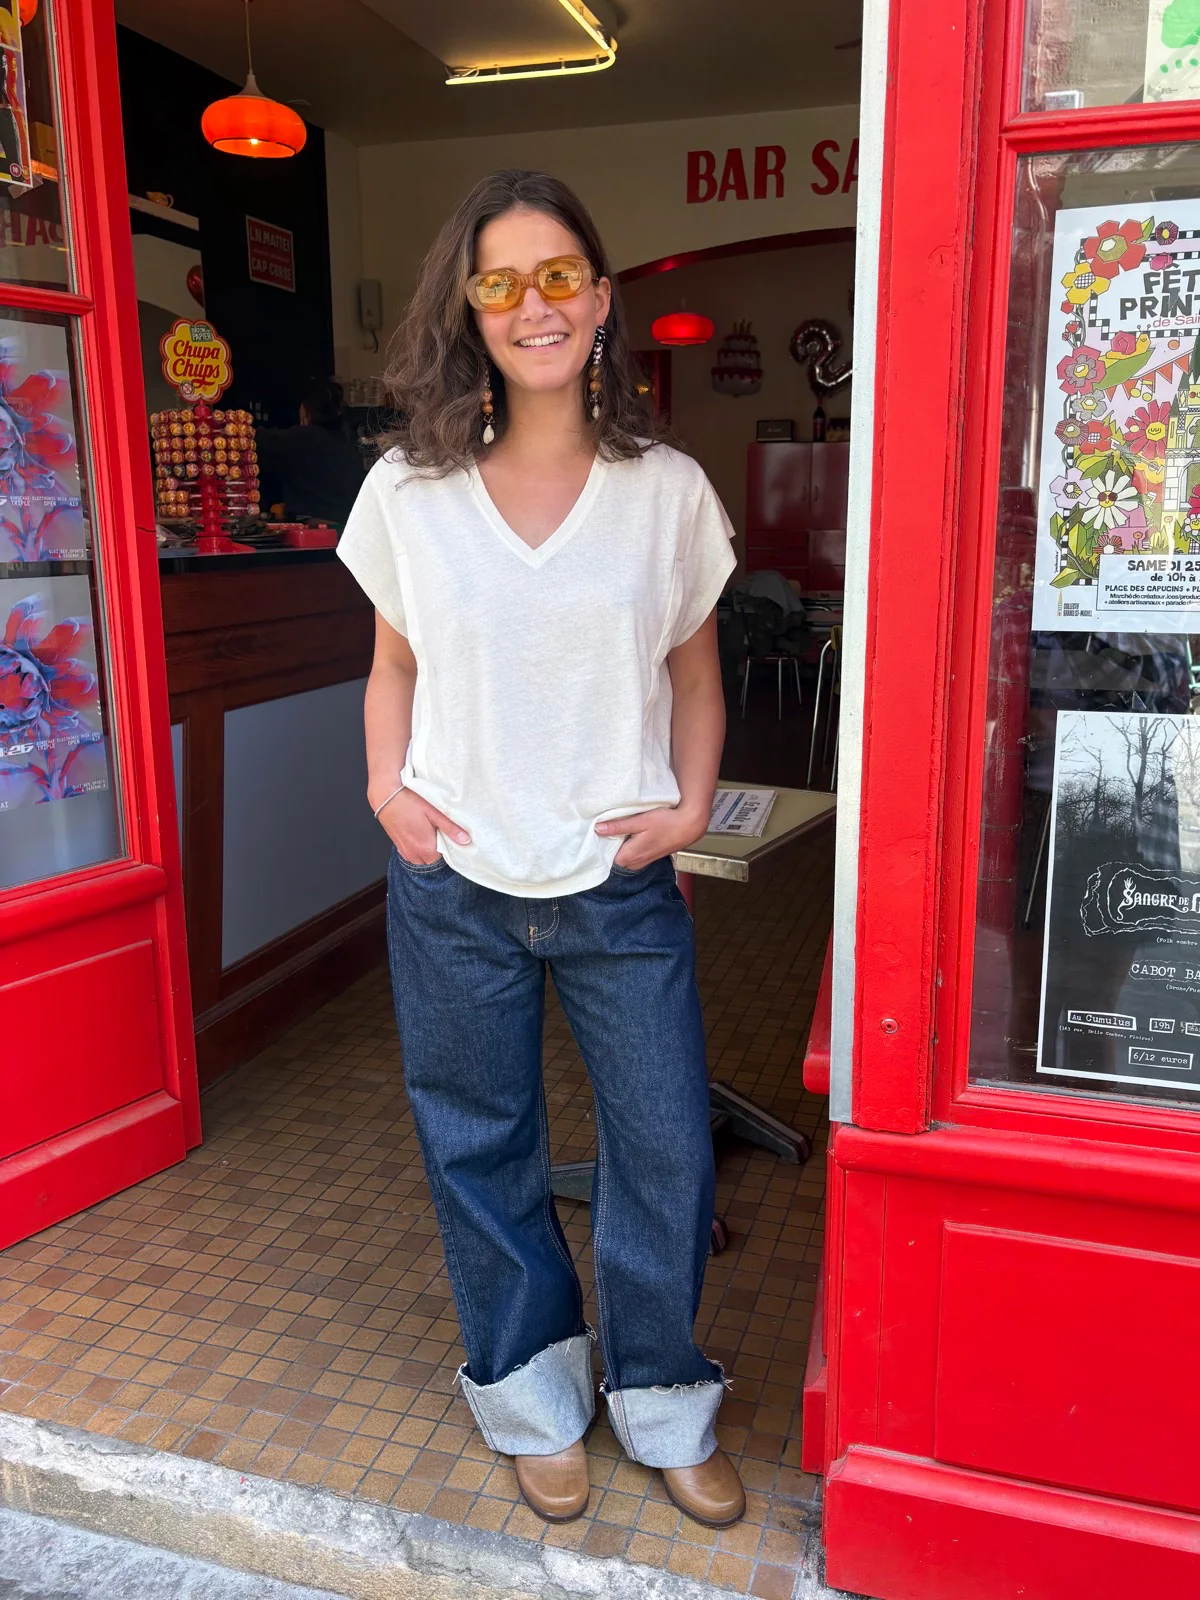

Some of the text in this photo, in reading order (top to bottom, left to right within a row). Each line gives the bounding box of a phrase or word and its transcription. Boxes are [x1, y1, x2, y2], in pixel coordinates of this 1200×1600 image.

[687, 145, 786, 204] BAR
[252, 257, 267, 273] CAP
[1153, 317, 1170, 328] de
[173, 340, 220, 363] Chupa
[172, 358, 220, 388] Chups
[1185, 560, 1200, 572] 25
[1150, 572, 1163, 582] de
[1167, 572, 1186, 582] 10h
[1189, 573, 1196, 582] à
[1117, 877, 1178, 921] SANGRE
[1178, 897, 1190, 906] DE
[1131, 964, 1176, 978] CABOT
[1085, 1014, 1131, 1028] Cumulus
[1153, 1021, 1171, 1030] 19h
[1133, 1051, 1188, 1065] 6/12 euros
